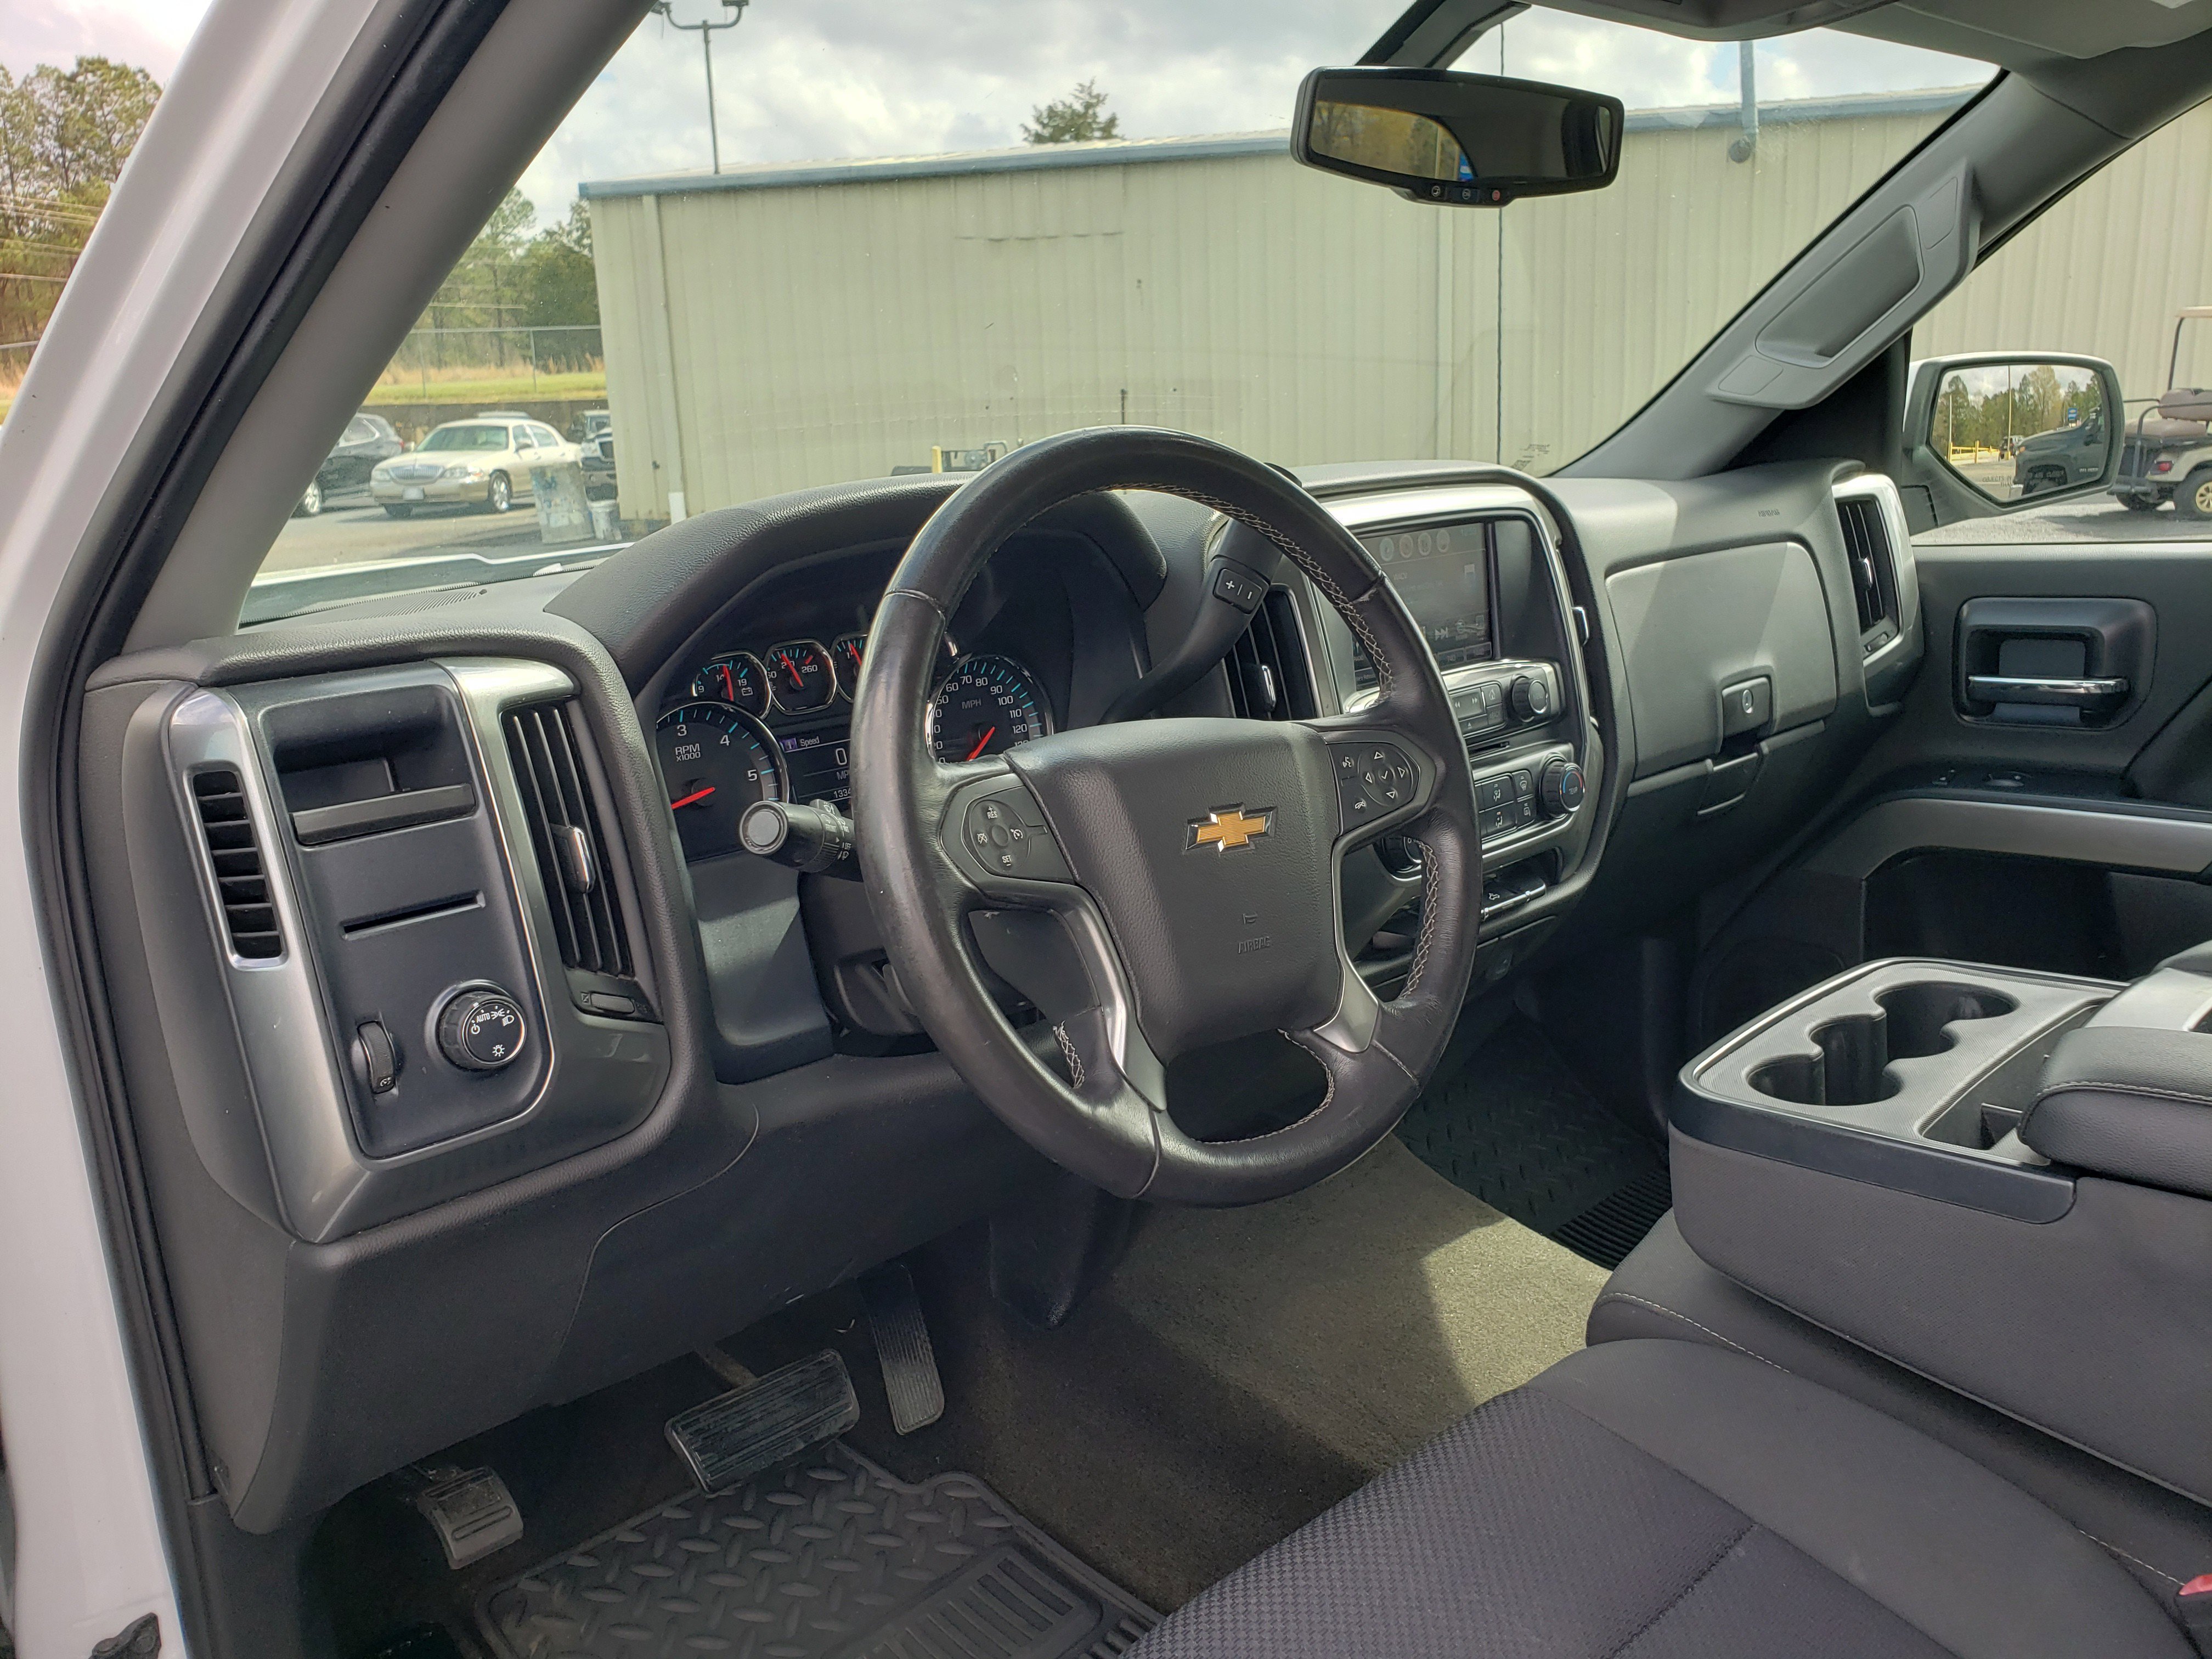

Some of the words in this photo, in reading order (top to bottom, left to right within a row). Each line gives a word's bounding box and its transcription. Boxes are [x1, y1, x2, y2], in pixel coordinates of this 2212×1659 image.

[781, 661, 795, 669] 20
[802, 664, 818, 674] 260
[715, 674, 725, 682] 14
[737, 679, 747, 687] 19
[960, 675, 972, 685] 70
[975, 677, 988, 687] 80
[946, 682, 958, 692] 60
[990, 685, 1003, 695] 90
[962, 698, 981, 709] MPH
[997, 696, 1014, 706] 100
[1009, 709, 1022, 719] 110
[676, 725, 687, 736] 3
[1012, 724, 1028, 734] 120
[720, 735, 730, 746] 4
[800, 736, 820, 747] Speed
[675, 743, 700, 755] RPM
[676, 752, 701, 762] x1000
[836, 748, 848, 765] 0
[747, 769, 758, 781] 5
[836, 770, 849, 781] MP
[1238, 936, 1271, 954] AIRBAG
[476, 1013, 490, 1023] AUTO
